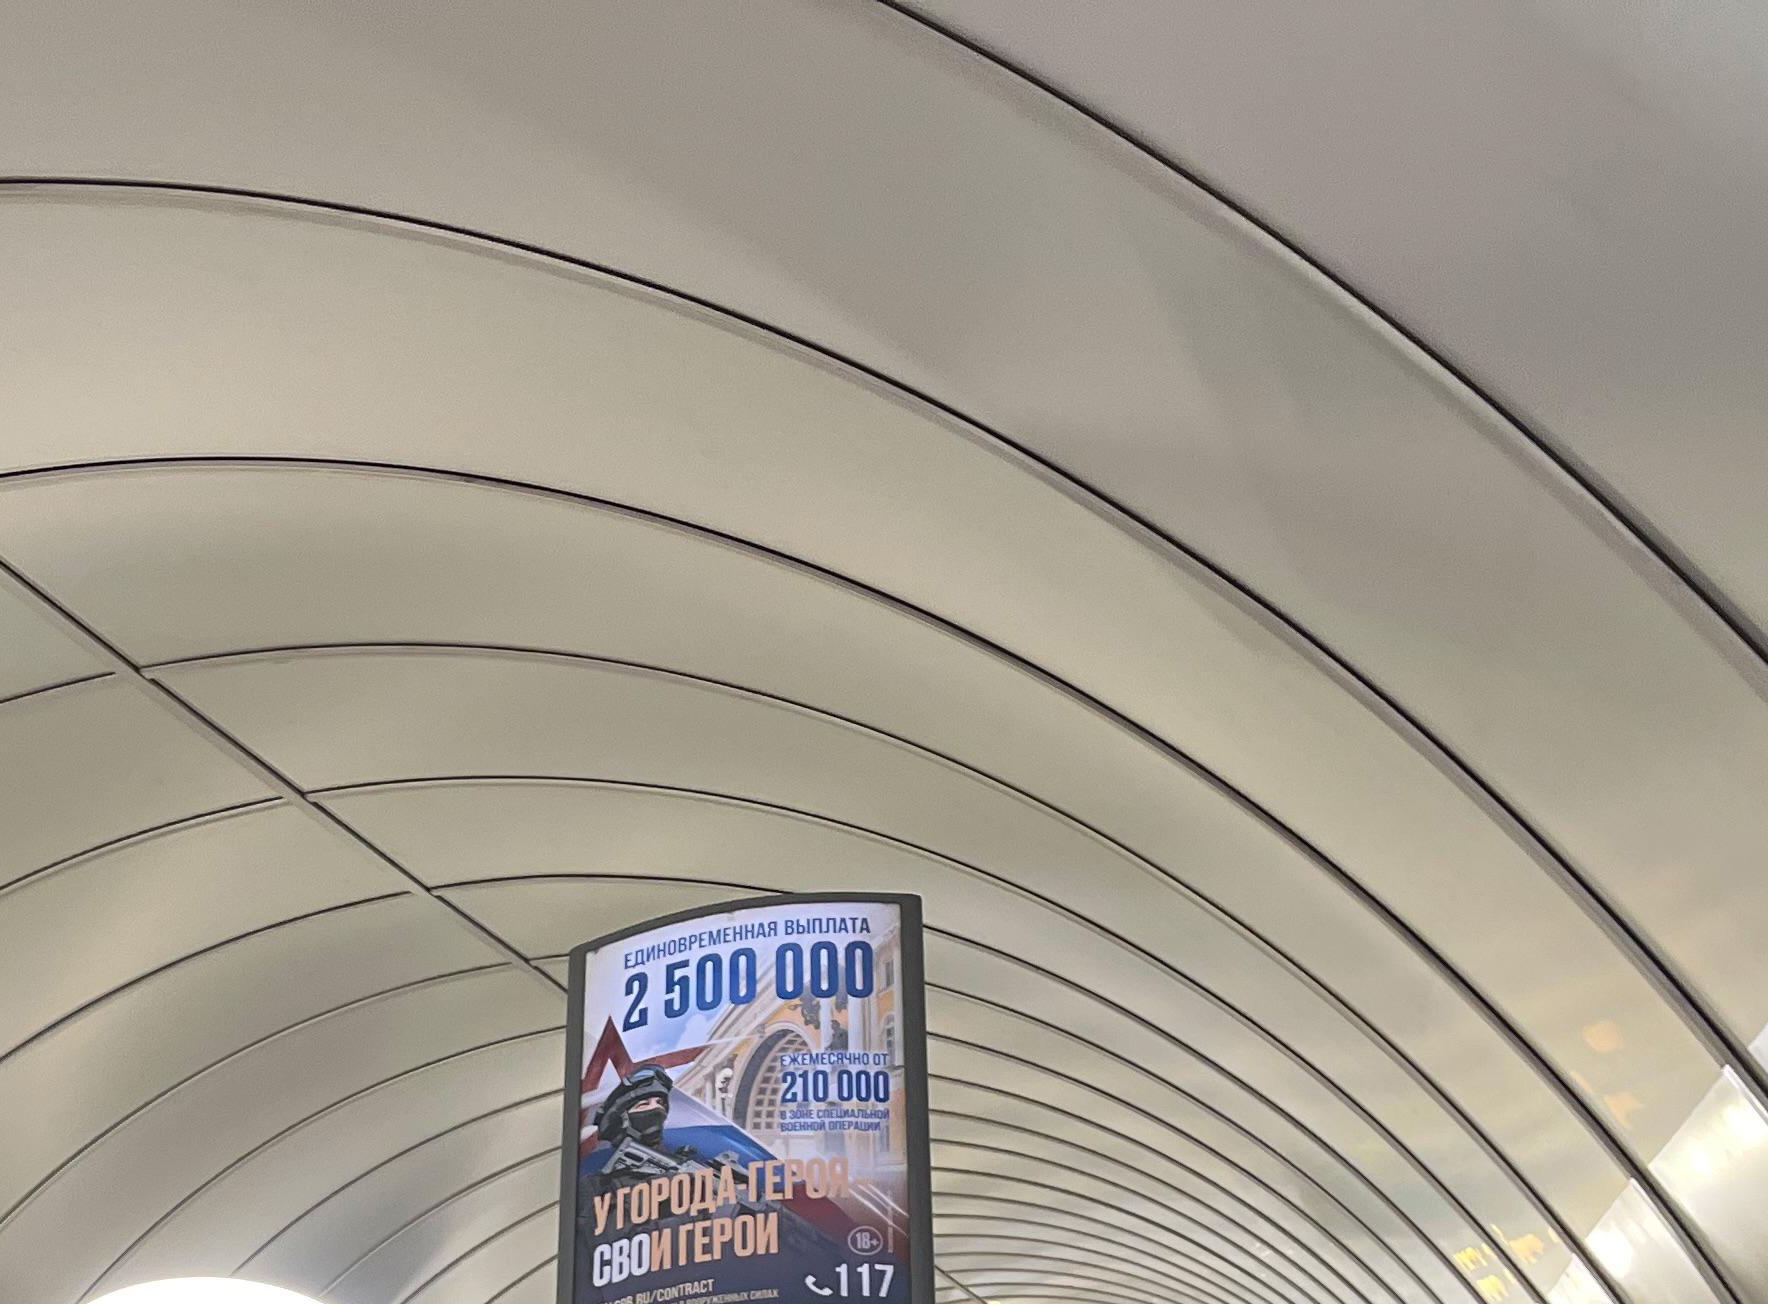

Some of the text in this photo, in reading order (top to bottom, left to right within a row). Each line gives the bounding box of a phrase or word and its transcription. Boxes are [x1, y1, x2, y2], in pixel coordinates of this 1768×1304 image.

[624, 917, 871, 969] ЕДИНОВРЕМЕННАЯ ВЫПЛАТА
[622, 940, 874, 1033] 2 500 000
[780, 1052, 889, 1067] ЕЖЕМЕСЯЧНО ОТ
[781, 1069, 890, 1103] 210 000
[780, 1120, 881, 1132] ВОЕННОЙ ОПЕРАЦИИ
[789, 1108, 814, 1120] ЗОНЕ
[816, 1107, 890, 1120] СПЕЦИАЛЬНОЙ
[593, 1193, 612, 1236] У
[615, 1157, 849, 1230] ГОРОДА-ГЕРОЯ
[592, 1212, 780, 1288] СВОИ ГЕРОИ
[855, 1231, 880, 1250] 18+
[835, 1262, 895, 1298] 117
